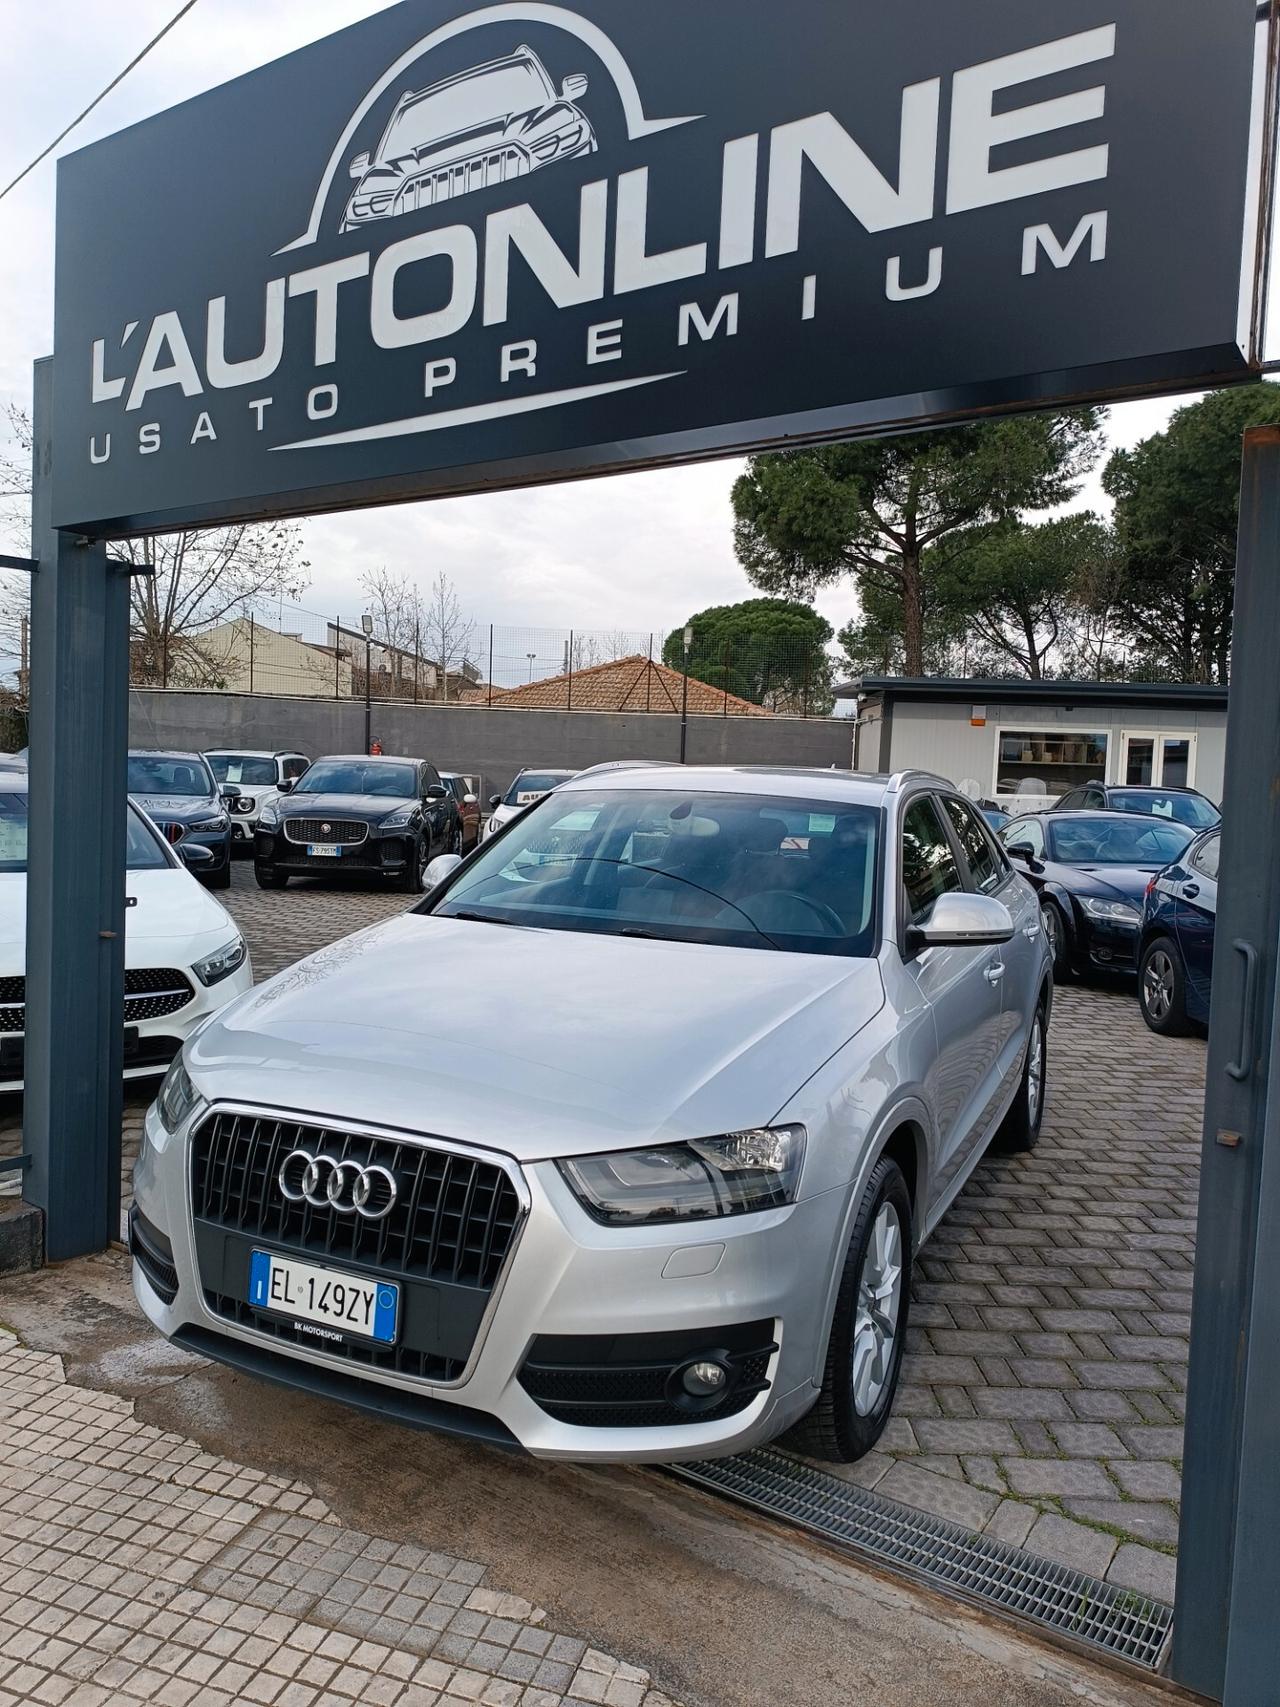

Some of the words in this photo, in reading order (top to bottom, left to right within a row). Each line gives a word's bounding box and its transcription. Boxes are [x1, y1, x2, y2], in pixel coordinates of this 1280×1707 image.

[92, 22, 1116, 411] L'AUTONLINE
[90, 383, 338, 464] USATO
[425, 210, 1108, 397] PREMIUM
[271, 1267, 295, 1304] EL
[308, 1277, 374, 1325] 149ZY
[294, 1322, 303, 1330] BK
[303, 1325, 343, 1342] MOTORSPORT
